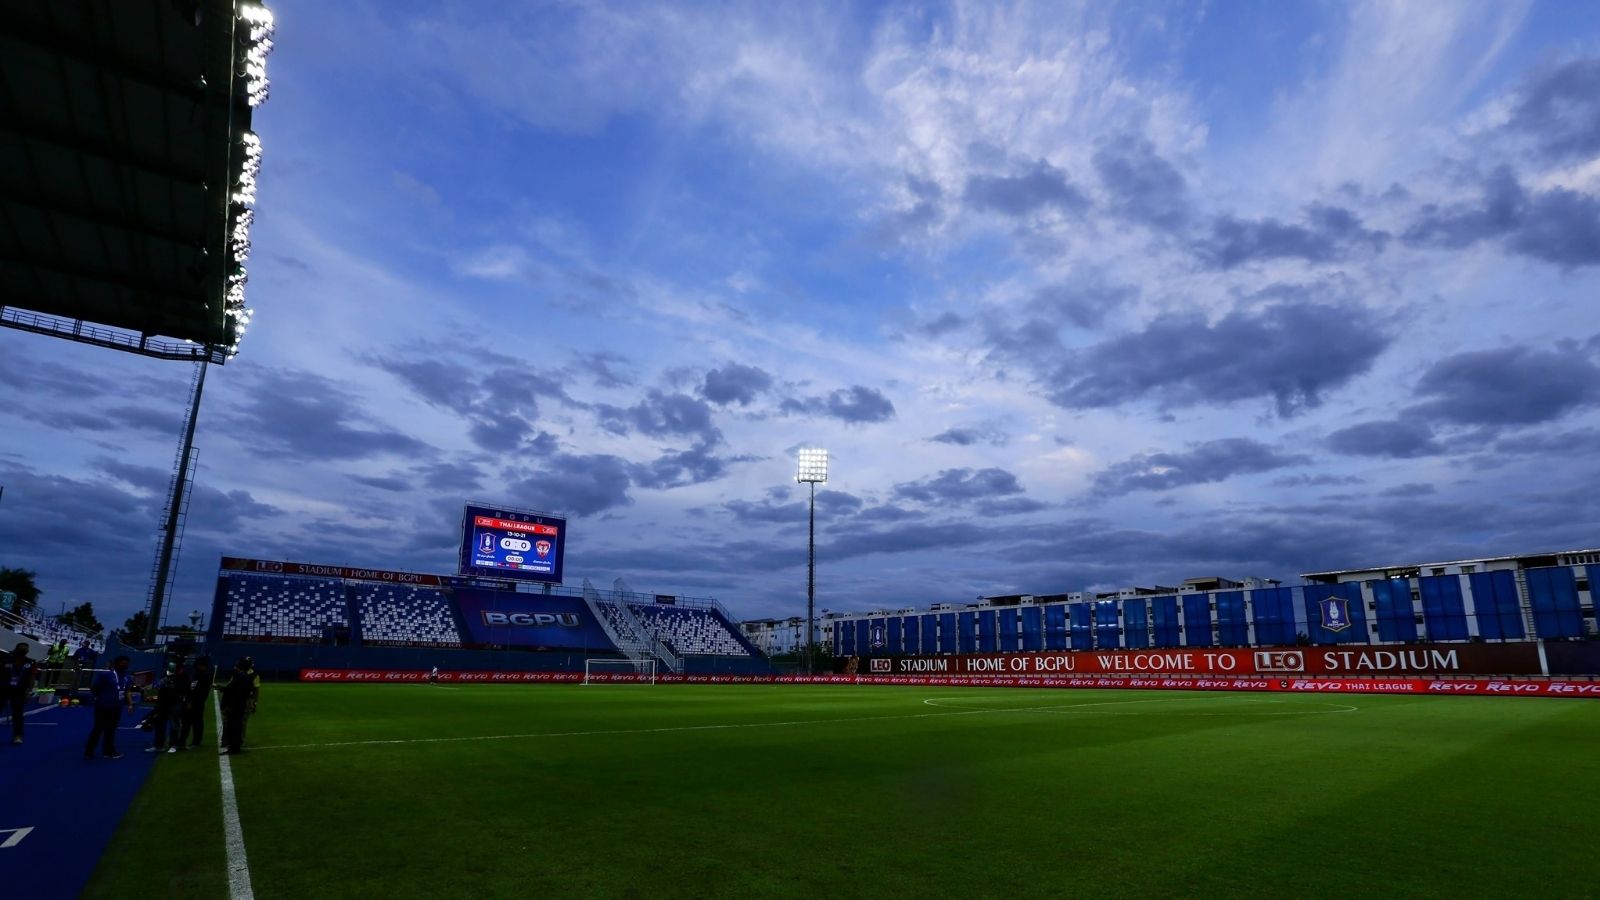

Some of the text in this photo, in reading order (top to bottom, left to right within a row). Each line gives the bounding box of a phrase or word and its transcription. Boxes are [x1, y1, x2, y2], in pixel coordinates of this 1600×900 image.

[513, 523, 535, 531] LEAGUE
[298, 565, 343, 577] STADIUM
[352, 570, 378, 579] HOME
[382, 572, 396, 581] OF
[398, 573, 422, 583] BGPU
[483, 612, 579, 627] BGPU
[871, 650, 1459, 671] LEO STADIUM HOME OF BGPU WELCOME TO LEO STADIUM
[305, 671, 341, 679] REVO
[346, 671, 381, 679] REVO
[385, 671, 418, 679] REVO
[1043, 678, 1066, 686] REVO
[1097, 679, 1124, 687] REVO
[1130, 679, 1158, 687] REVO
[1162, 679, 1192, 687] REVO
[1196, 680, 1229, 688] REVO
[1233, 680, 1268, 688] REVO
[1292, 681, 1342, 690] REVO
[1373, 683, 1414, 691] LEAGUE
[1428, 682, 1478, 691] REVO
[1485, 683, 1540, 692] REVO
